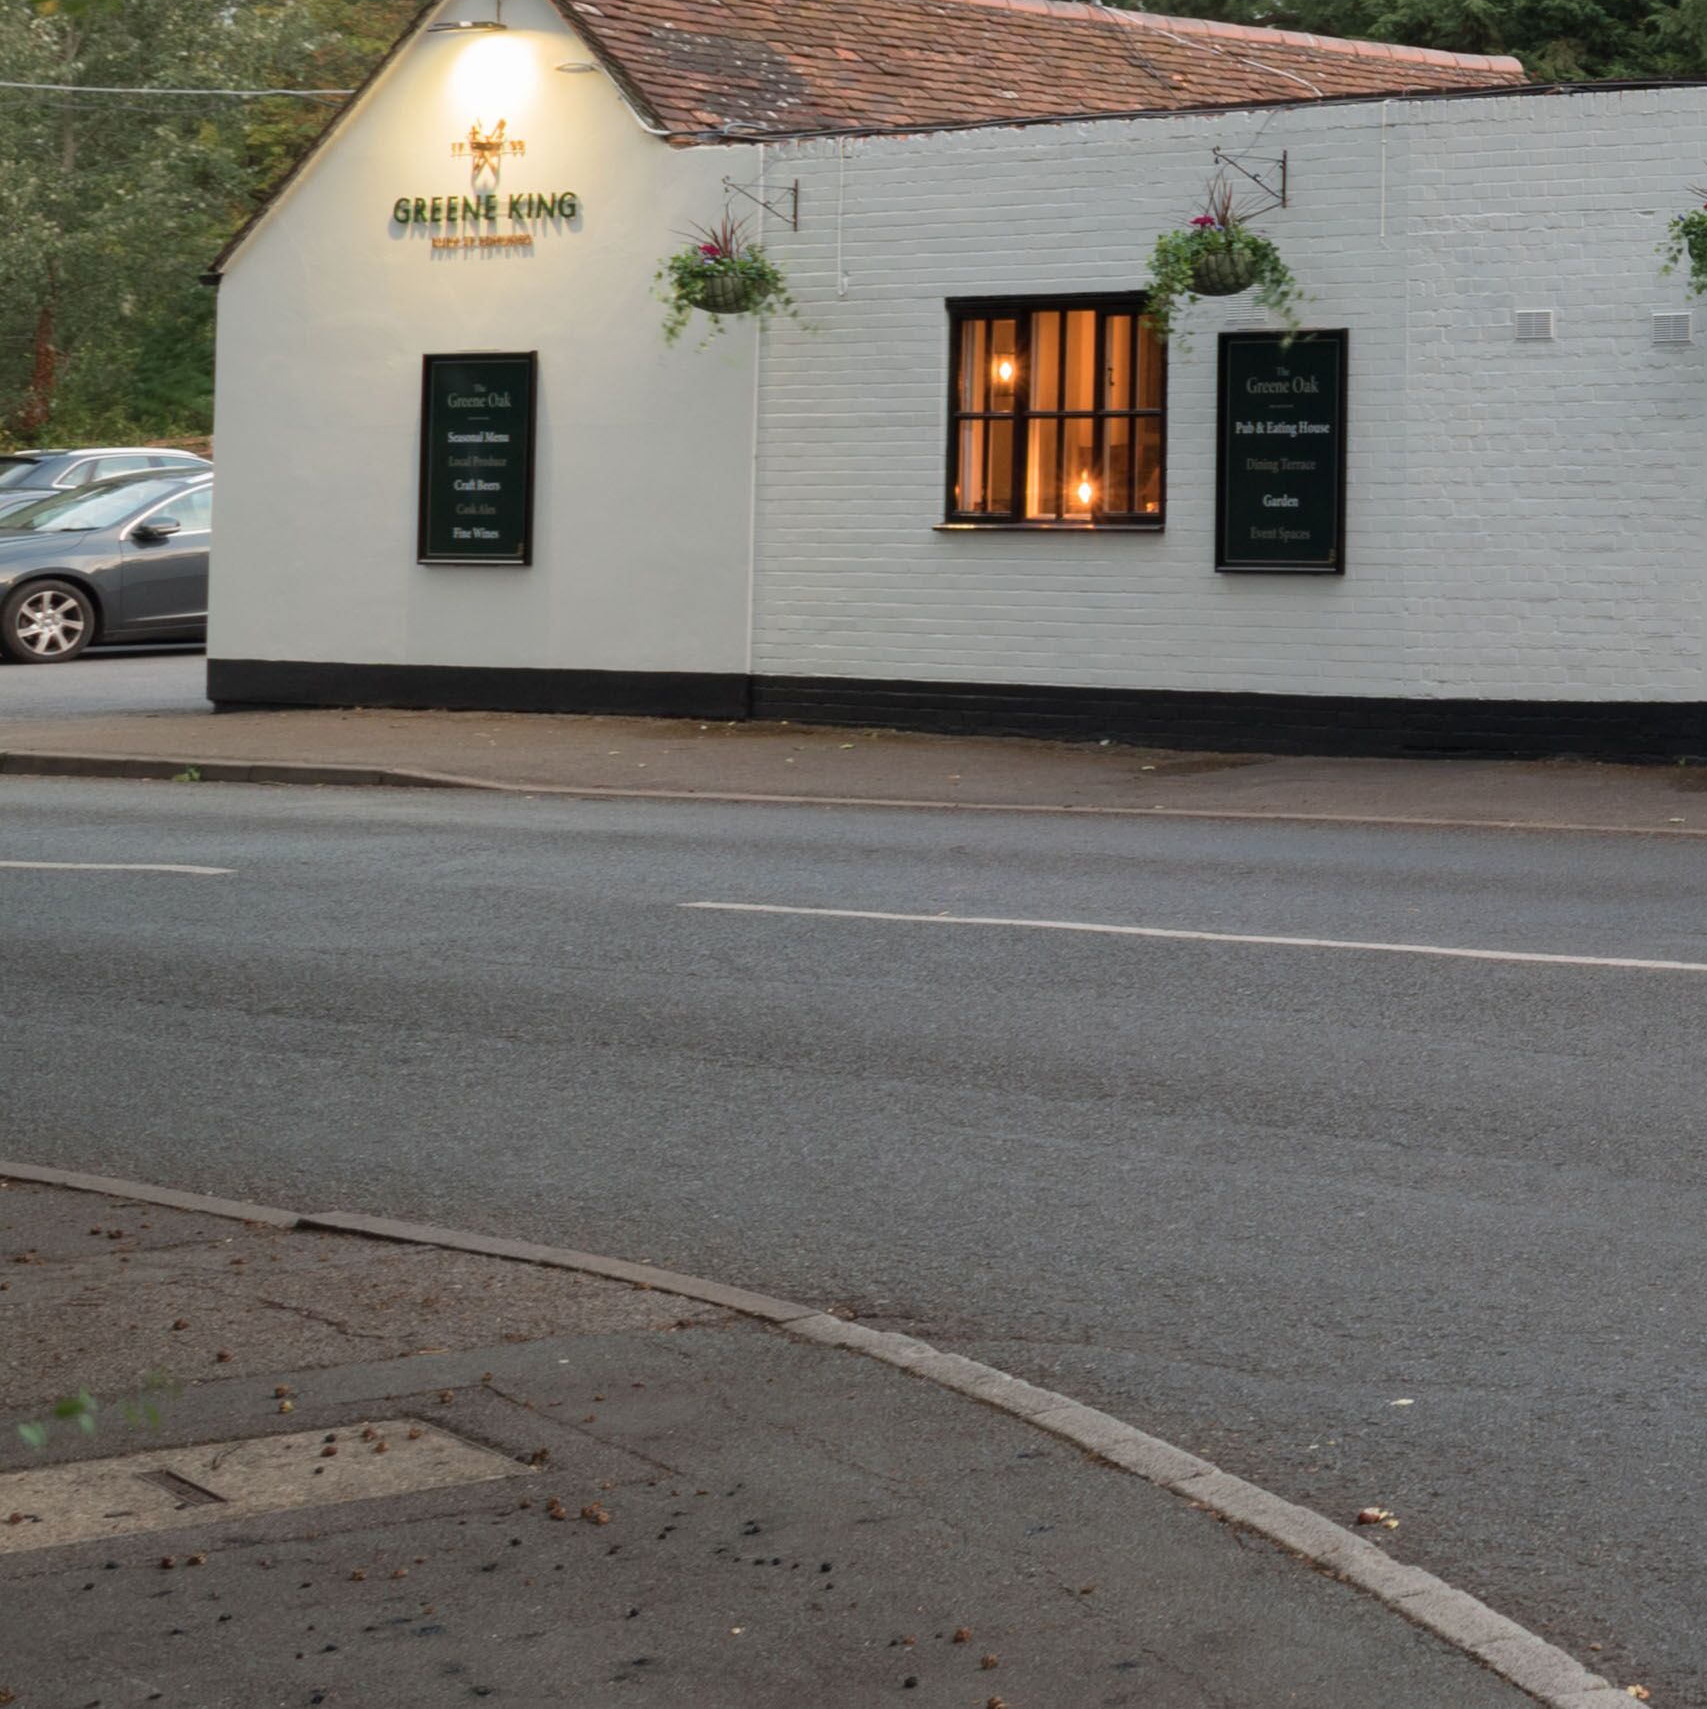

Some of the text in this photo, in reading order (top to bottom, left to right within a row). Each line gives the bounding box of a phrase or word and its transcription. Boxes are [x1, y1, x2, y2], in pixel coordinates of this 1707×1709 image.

[393, 192, 578, 224] GREENE KING
[1246, 375, 1319, 394] Greene Oak
[1235, 420, 1331, 438] Pub & Eating House
[453, 479, 501, 491] Craft Beers
[1263, 493, 1299, 507] Garden
[453, 527, 500, 539] Fine Wines
